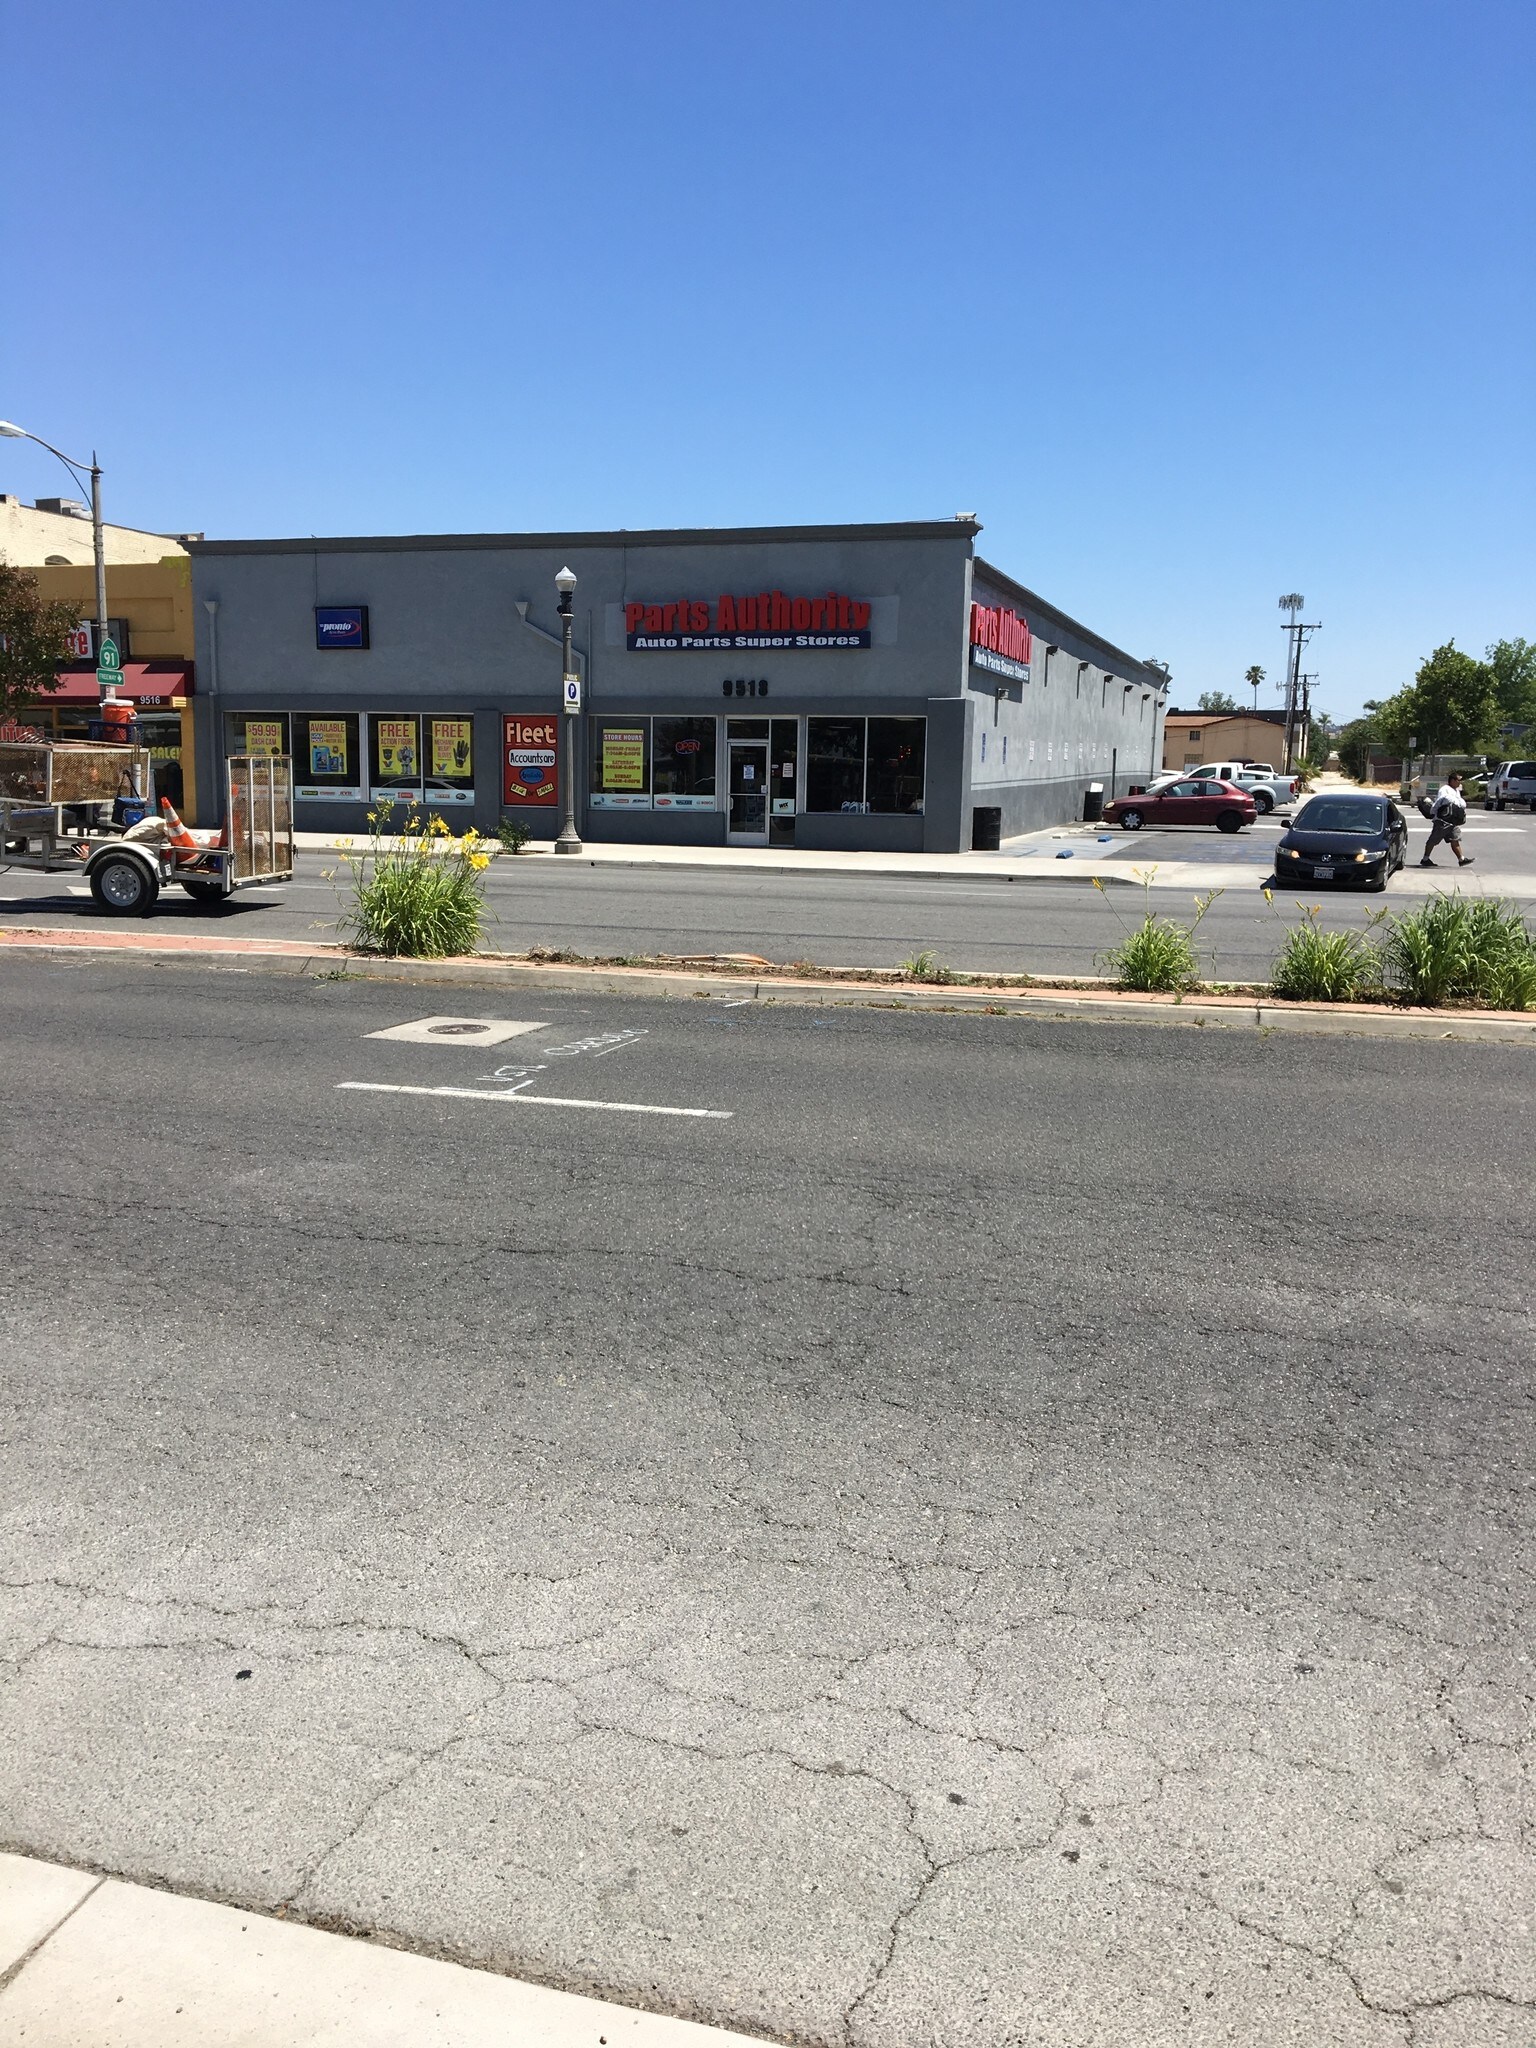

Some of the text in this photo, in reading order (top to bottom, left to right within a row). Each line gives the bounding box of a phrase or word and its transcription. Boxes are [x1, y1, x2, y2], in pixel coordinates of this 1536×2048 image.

[626, 590, 872, 633] Parts Authority
[322, 622, 352, 632] pronto
[970, 604, 998, 651] Parts
[636, 635, 860, 648] Auto Parts Super Stores
[104, 652, 114, 666] 91
[974, 650, 1028, 681] Auto Parts Super Stores
[98, 672, 116, 681] FREEWAY
[570, 684, 576, 697] P
[722, 680, 769, 696] 9518
[140, 696, 160, 704] 9516
[248, 724, 277, 736] $59.99
[310, 723, 345, 732] AVAILABLE
[380, 724, 410, 737] FREE
[434, 724, 464, 738] FREE
[506, 722, 556, 744] Fleet
[676, 741, 700, 752] OPEN
[510, 752, 554, 764] Accounts are
